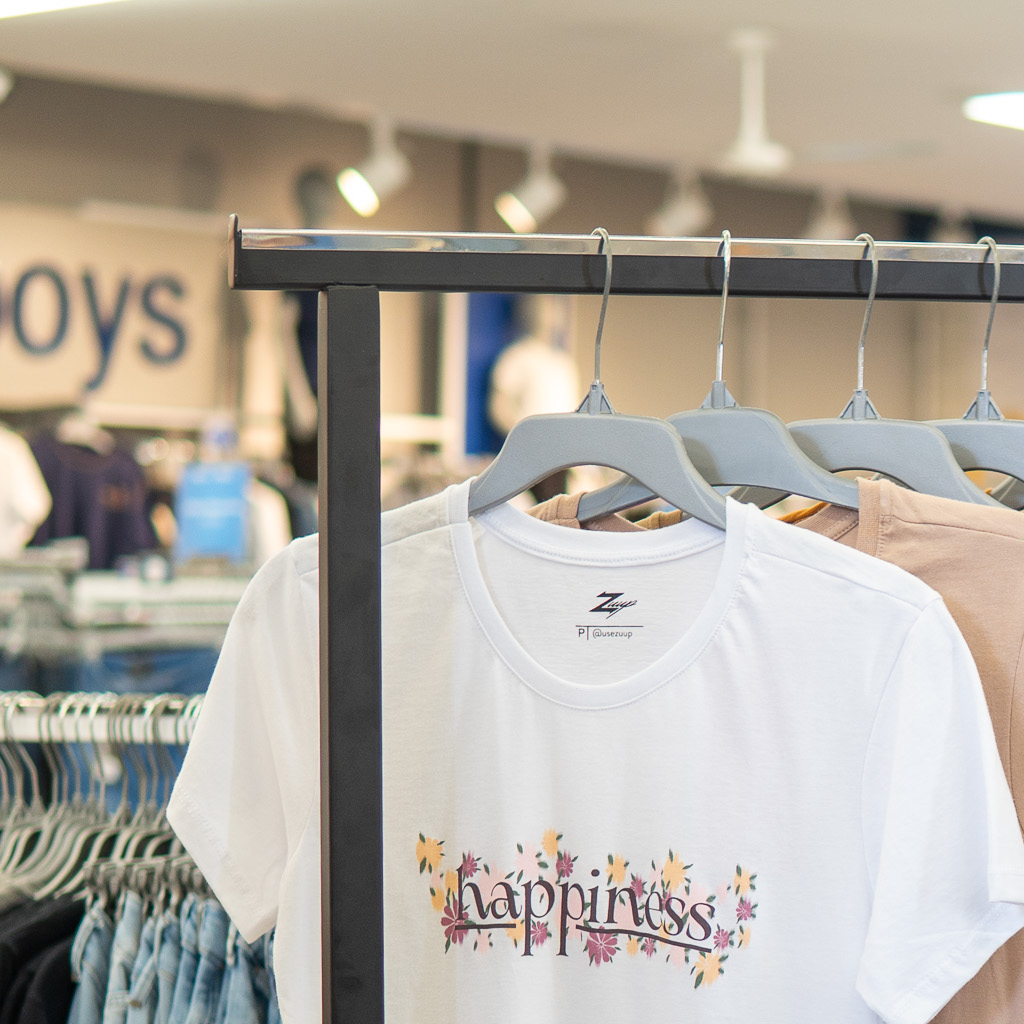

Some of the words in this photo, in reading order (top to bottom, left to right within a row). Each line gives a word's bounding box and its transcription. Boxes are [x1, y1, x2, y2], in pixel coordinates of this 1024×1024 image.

[0, 263, 188, 391] oys
[578, 628, 586, 638] P
[592, 628, 633, 639] @usezuup
[455, 863, 716, 957] happiness
